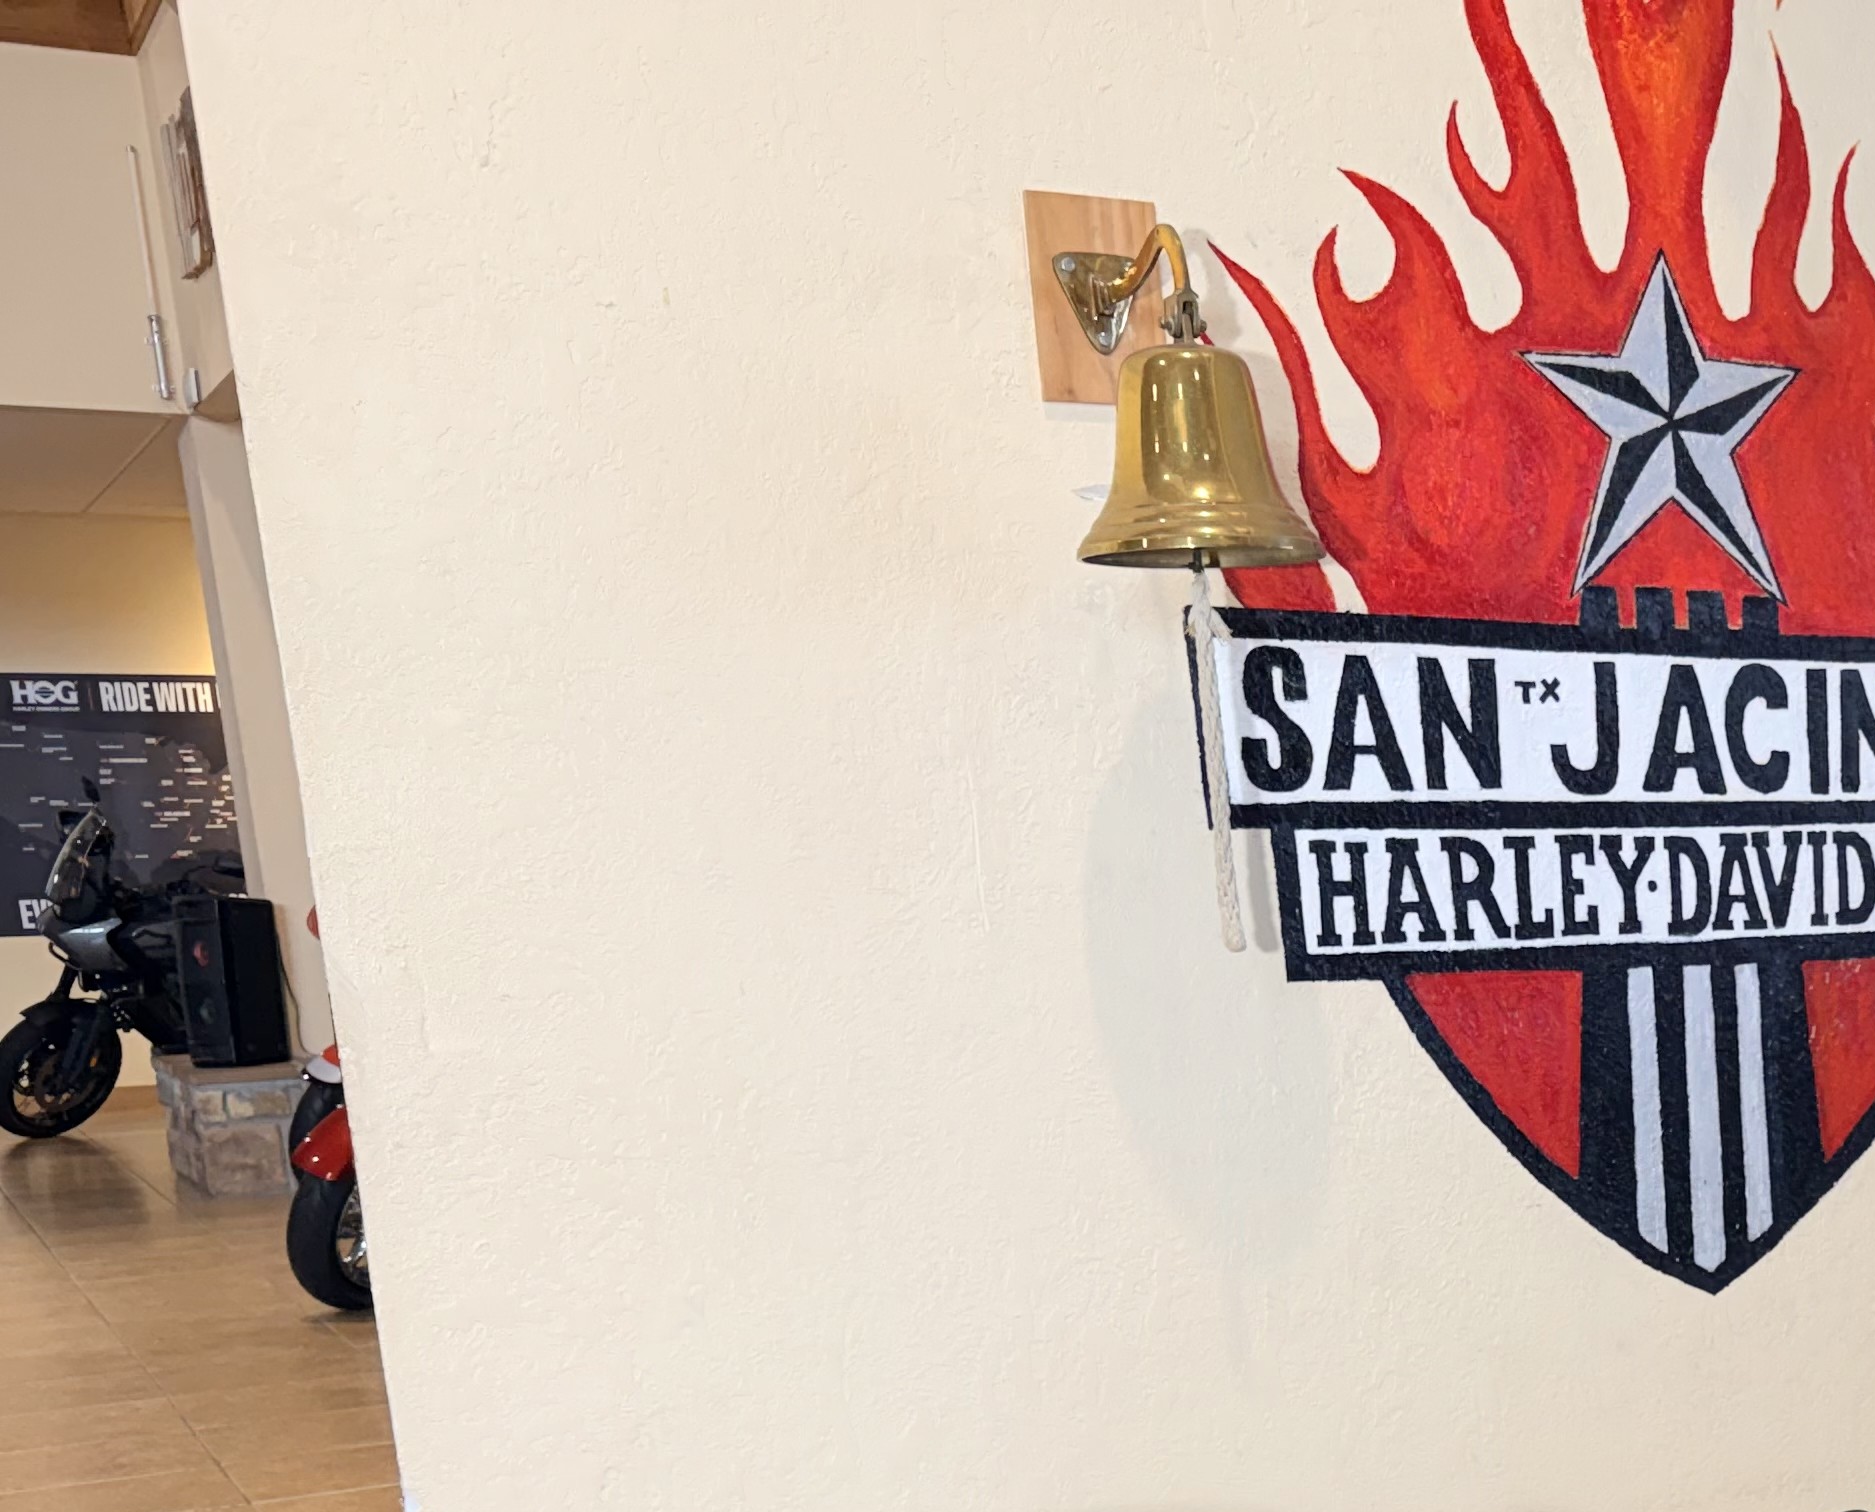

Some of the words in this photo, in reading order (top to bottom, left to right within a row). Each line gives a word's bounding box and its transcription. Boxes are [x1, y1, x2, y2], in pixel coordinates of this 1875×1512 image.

[9, 680, 78, 704] HOG
[98, 681, 153, 713] RIDE
[152, 681, 214, 713] WITH
[1240, 645, 1502, 792] SAN
[1514, 678, 1560, 704] TX
